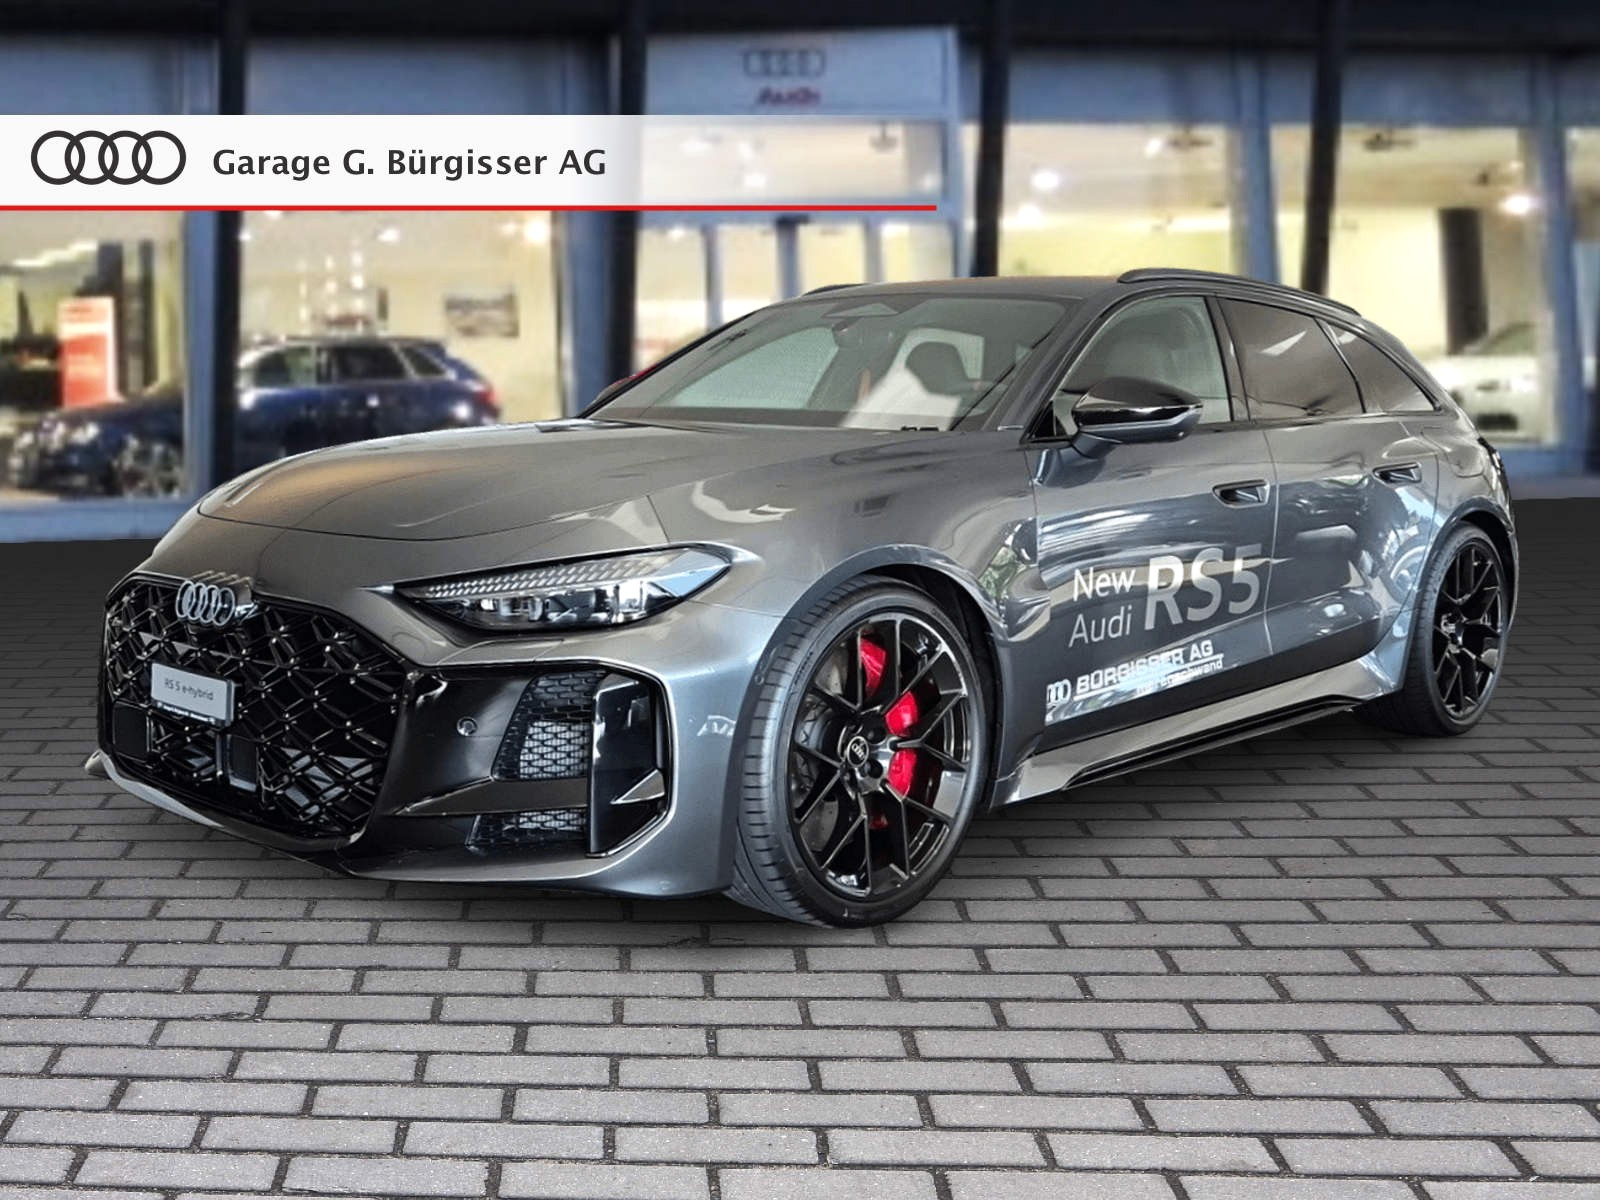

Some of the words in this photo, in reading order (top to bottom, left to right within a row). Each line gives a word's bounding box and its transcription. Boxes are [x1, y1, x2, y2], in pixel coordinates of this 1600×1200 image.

[1073, 566, 1135, 601] New
[1068, 605, 1132, 648] Audi
[1189, 640, 1214, 661] AG
[182, 685, 214, 701] e-hybrid
